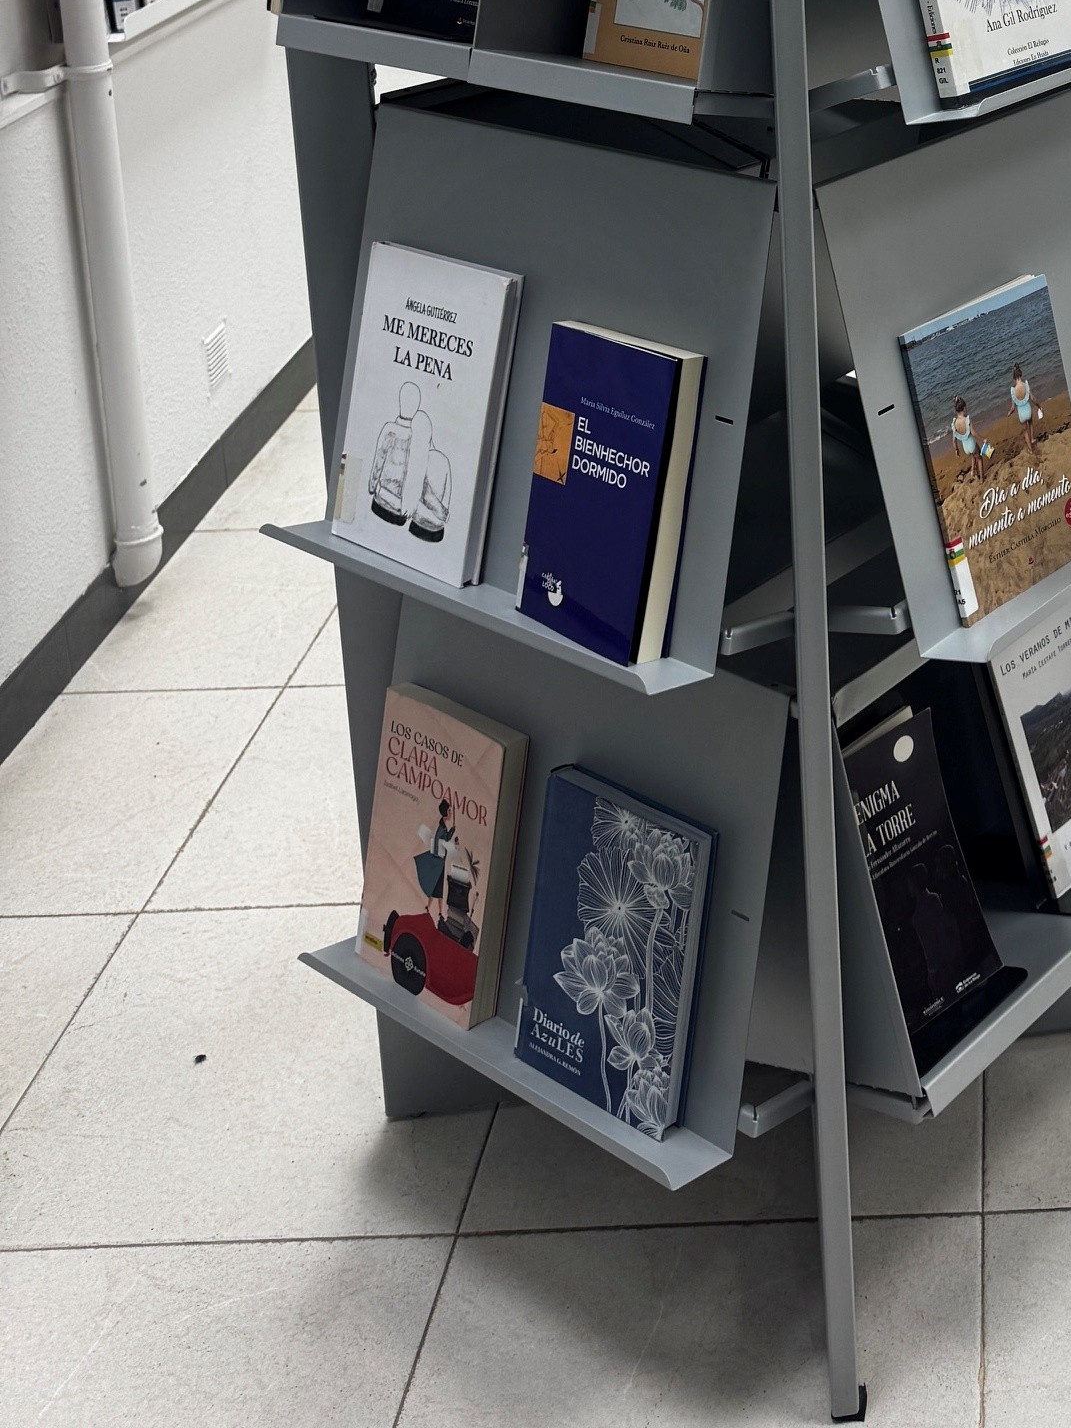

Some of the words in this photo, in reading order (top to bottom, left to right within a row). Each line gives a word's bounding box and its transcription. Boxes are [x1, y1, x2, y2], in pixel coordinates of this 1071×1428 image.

[986, 18, 1002, 32] Ana
[1002, 12, 1016, 28] Gil
[1017, 2, 1058, 25] Rodríguez
[620, 34, 643, 47] Cristina
[671, 42, 678, 53] de
[1007, 42, 1028, 56] Colección
[1032, 38, 1050, 49] Refugio
[936, 67, 946, 75] 821
[938, 76, 949, 84] GIL
[405, 297, 427, 315] ÁNGELA
[427, 305, 458, 324] GUTIÉRREZ
[382, 315, 406, 337] ME
[407, 321, 474, 358] MERECES
[393, 346, 413, 368] LA
[415, 352, 453, 381] PENA
[577, 416, 592, 435] EL
[596, 400, 610, 413] Silvia
[630, 414, 656, 430] González
[571, 455, 628, 489] DORMIDO
[574, 436, 651, 478] BIENHECHOR
[979, 487, 1008, 519] Día
[1010, 483, 1021, 497] a
[1021, 466, 1044, 491] día,
[968, 505, 1017, 550] momento
[1017, 507, 1027, 520] a
[988, 548, 1010, 565] ESTHER
[1000, 658, 1017, 676] LOS
[1019, 634, 1051, 664] VERANOS
[1052, 624, 1064, 641] DE
[388, 736, 439, 778] CLARA
[390, 720, 413, 740] LOS
[413, 730, 450, 760] CASOS
[451, 749, 465, 768] DE
[385, 755, 489, 828] CAMPOAMOR
[854, 780, 901, 826] ENIGMA
[876, 803, 917, 850] TORRE
[530, 1023, 584, 1063] AzuLES
[533, 1007, 570, 1040] Diario
[570, 1032, 585, 1048] de
